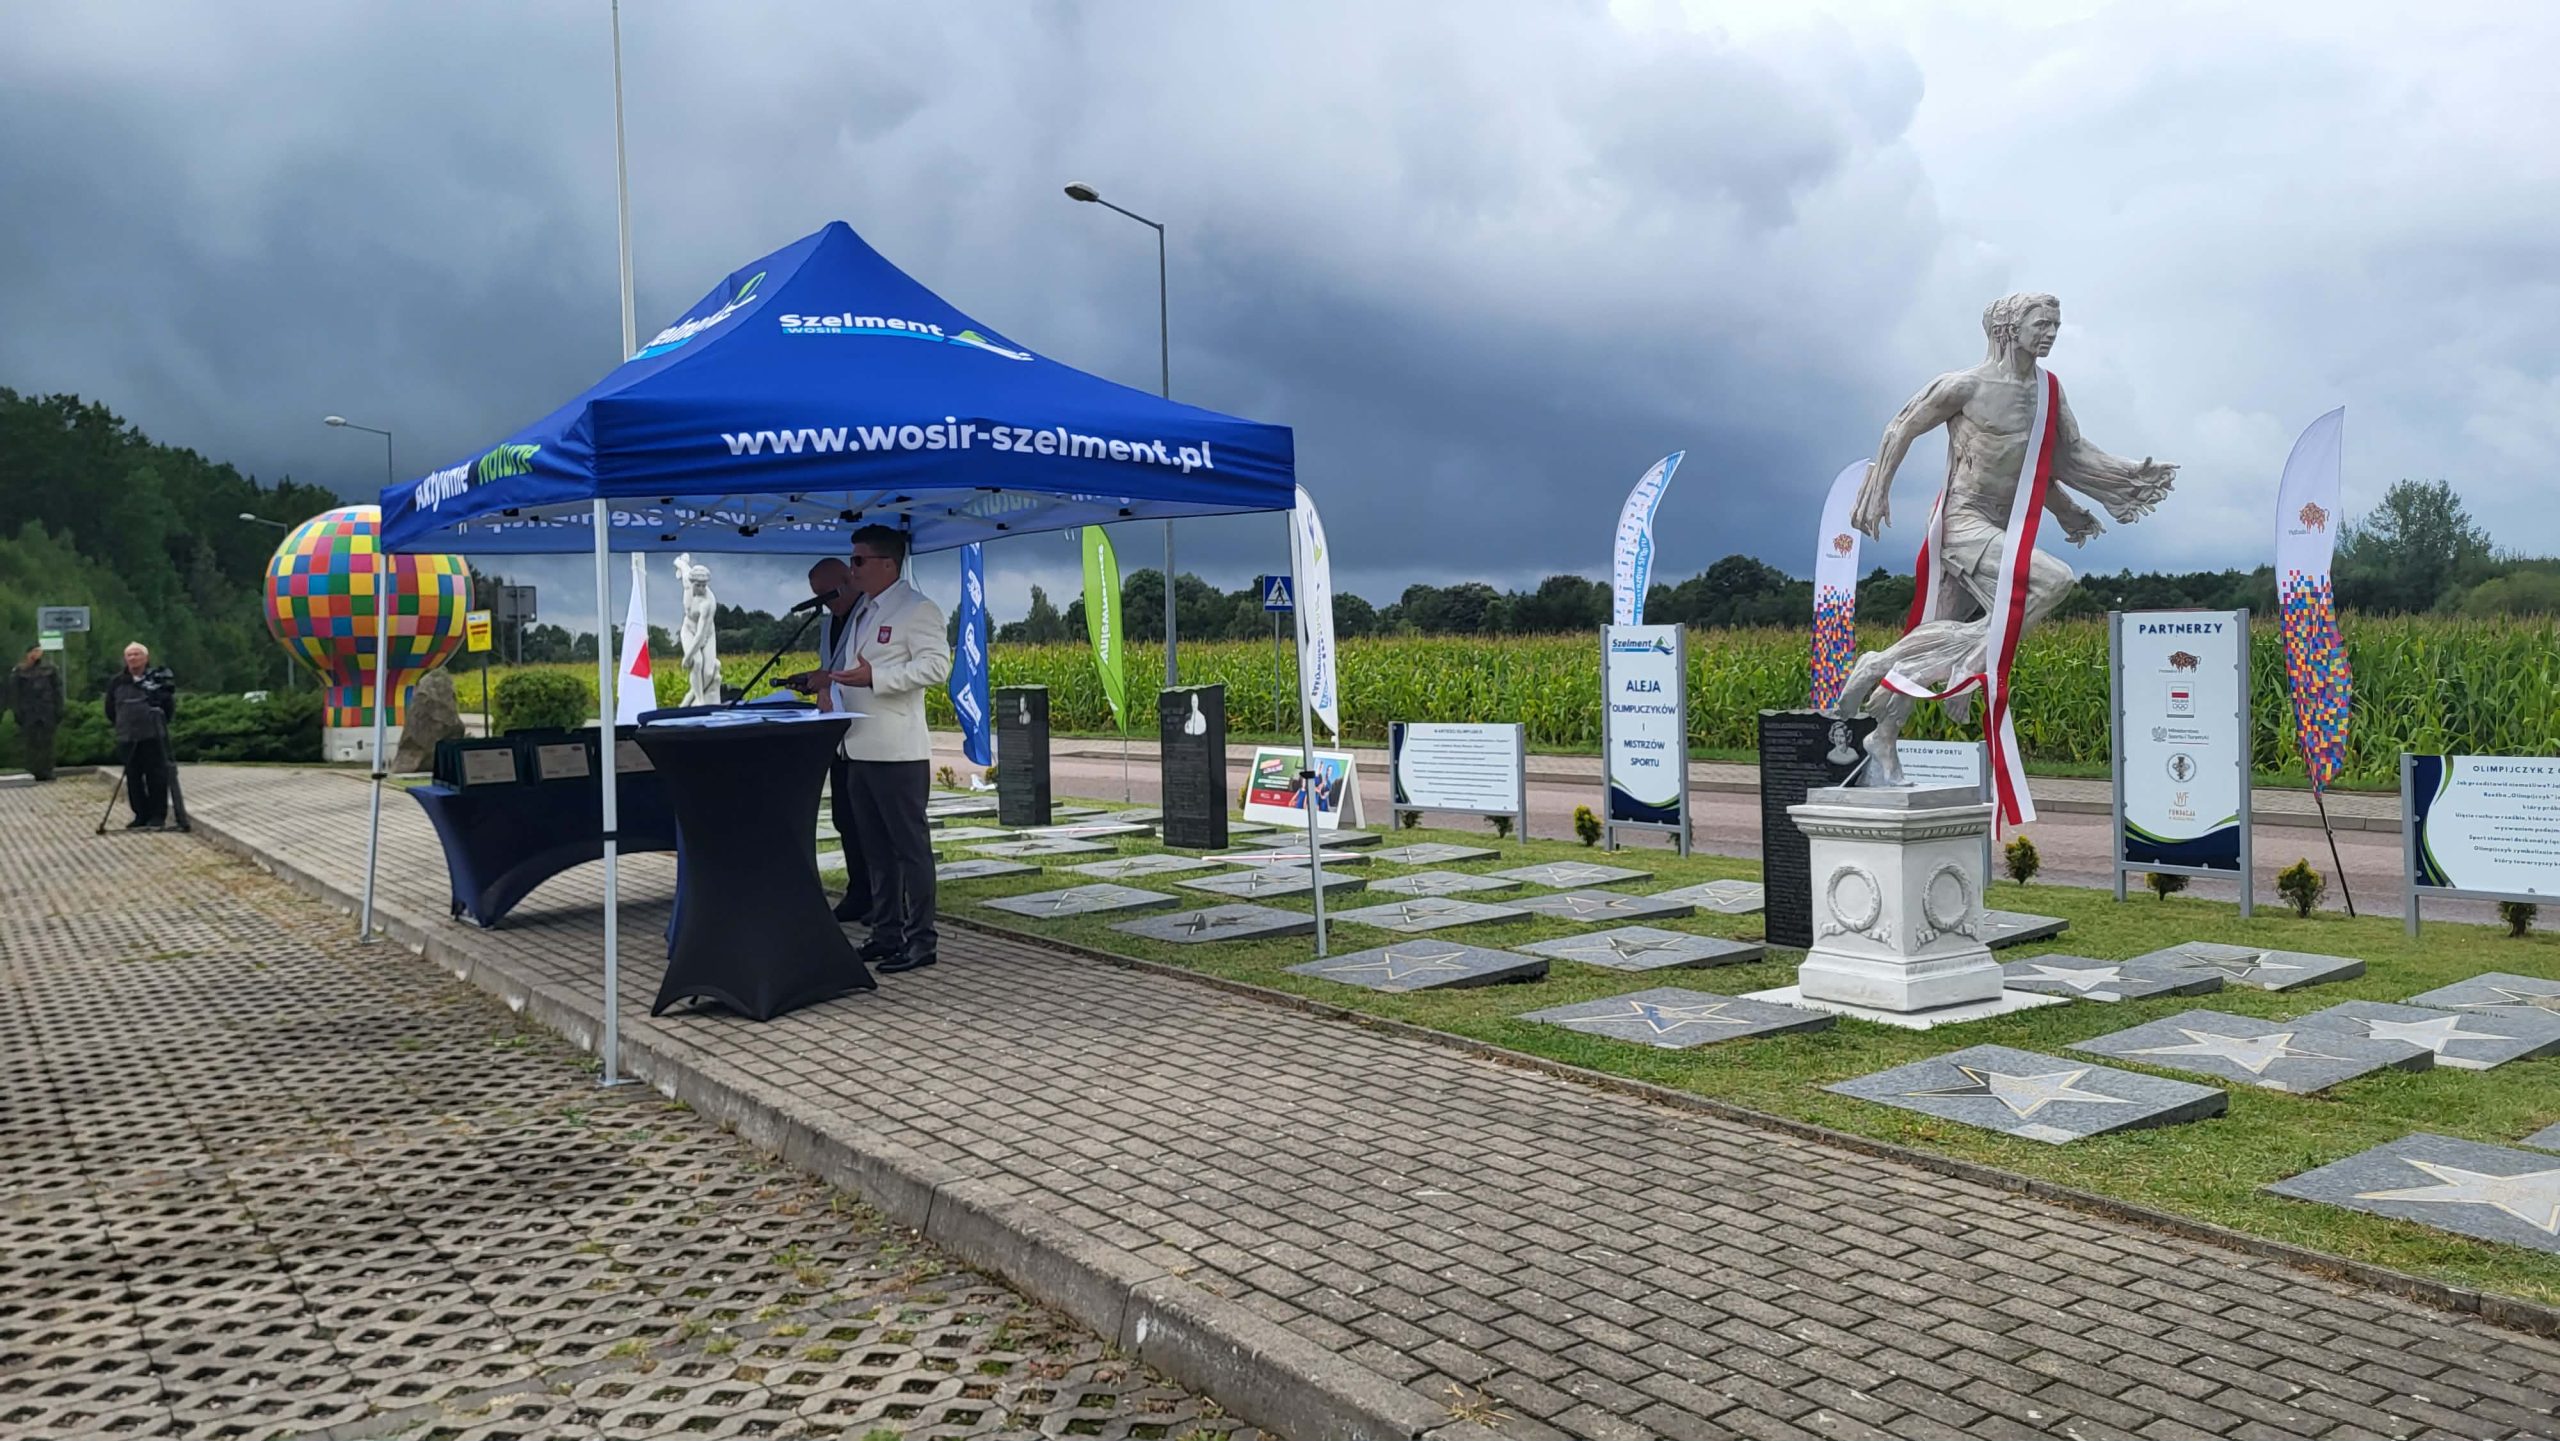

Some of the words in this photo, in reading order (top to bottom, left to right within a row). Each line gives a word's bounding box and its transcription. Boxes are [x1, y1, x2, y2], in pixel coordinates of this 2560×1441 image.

[779, 312, 945, 337] Szelment
[721, 416, 1214, 473] www.wosir-szelment.pl
[2139, 623, 2222, 634] PARTNERZY
[1612, 638, 1652, 648] Szelment
[1626, 680, 1661, 692] ALEJA
[1612, 703, 1676, 714] OLIMPIJCZYKÓW
[1624, 740, 1665, 750] MISTRZÓW
[1630, 758, 1660, 767] SPORTU
